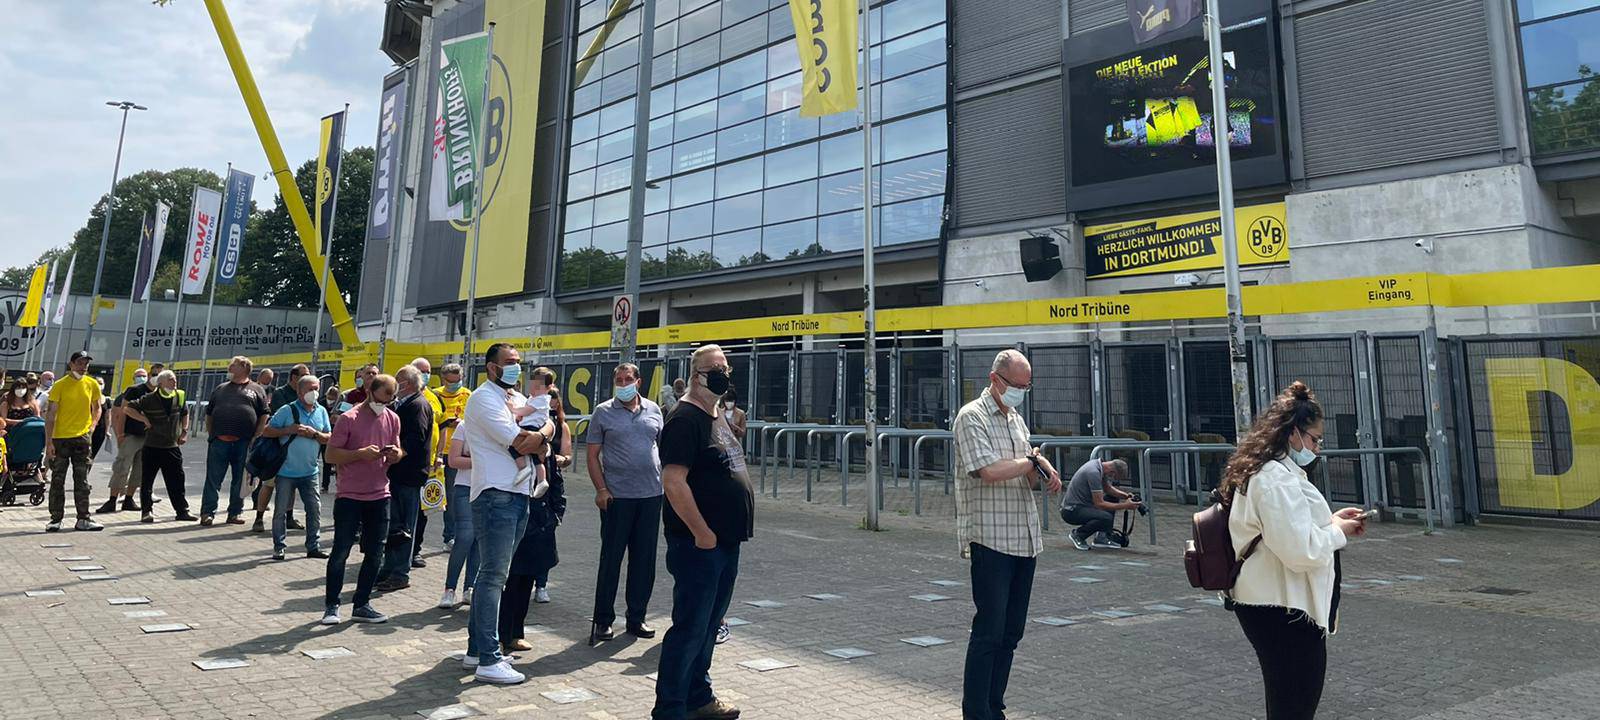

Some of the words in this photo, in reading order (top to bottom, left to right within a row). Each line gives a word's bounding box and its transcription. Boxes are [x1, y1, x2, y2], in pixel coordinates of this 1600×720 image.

[1096, 66, 1112, 78] DIE
[1114, 56, 1142, 74] NEUE
[1097, 237, 1144, 255] HERZLICH
[1148, 221, 1220, 245] WILLKOMMEN
[1103, 233, 1118, 241] LIEBE
[1252, 220, 1282, 246] BVB
[188, 211, 209, 281] ROWE
[203, 228, 213, 259] MOTOR
[1262, 245, 1273, 254] 09
[1104, 257, 1119, 271] IN
[1121, 239, 1205, 268] DORTMUND!
[1379, 279, 1397, 289] VIP
[1368, 290, 1411, 301] Eingang
[1049, 303, 1078, 319] Nord
[1081, 301, 1130, 316] Tribüne
[186, 326, 201, 336] im
[242, 325, 263, 335] alle
[266, 324, 311, 334] Theorie,
[772, 321, 789, 331] Nord
[791, 319, 819, 330] Tribüne
[246, 334, 261, 344] ist
[262, 334, 293, 343] auf'm
